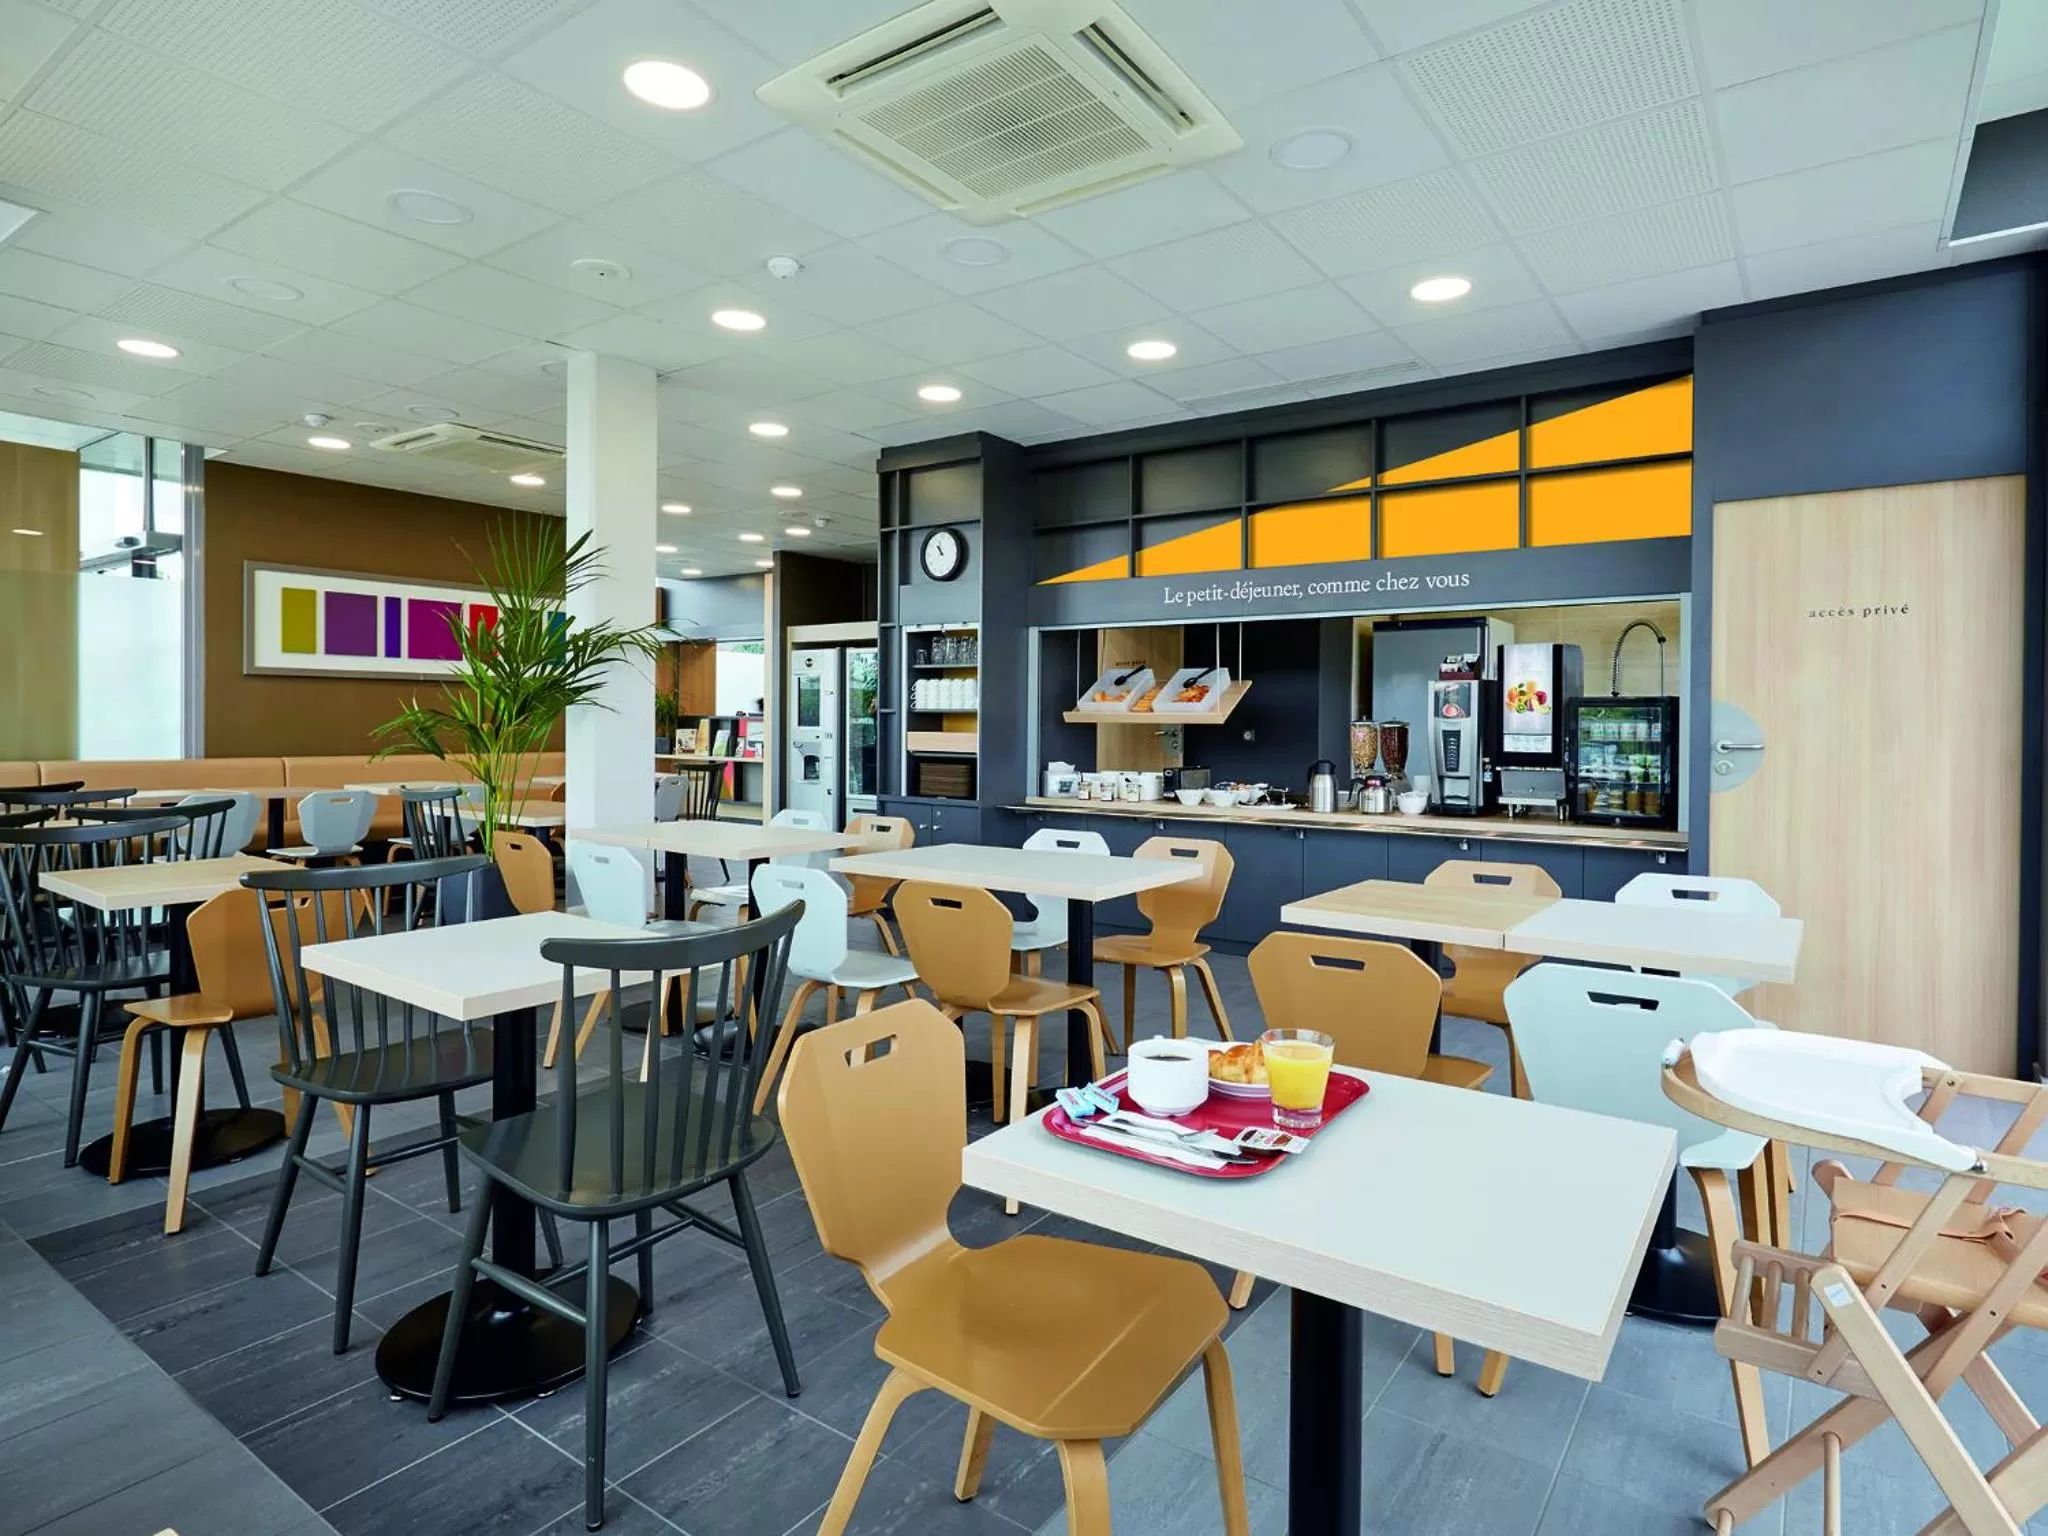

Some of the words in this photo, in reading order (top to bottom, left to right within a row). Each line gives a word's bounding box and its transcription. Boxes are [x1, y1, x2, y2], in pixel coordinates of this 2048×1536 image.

[1164, 587, 1184, 604] Le
[1186, 580, 1303, 606] petit-déjeuner,
[1308, 578, 1370, 595] comme
[1375, 572, 1419, 591] chez
[1425, 573, 1469, 588] vous
[1809, 606, 1855, 618] accès
[1862, 602, 1909, 618] privé
